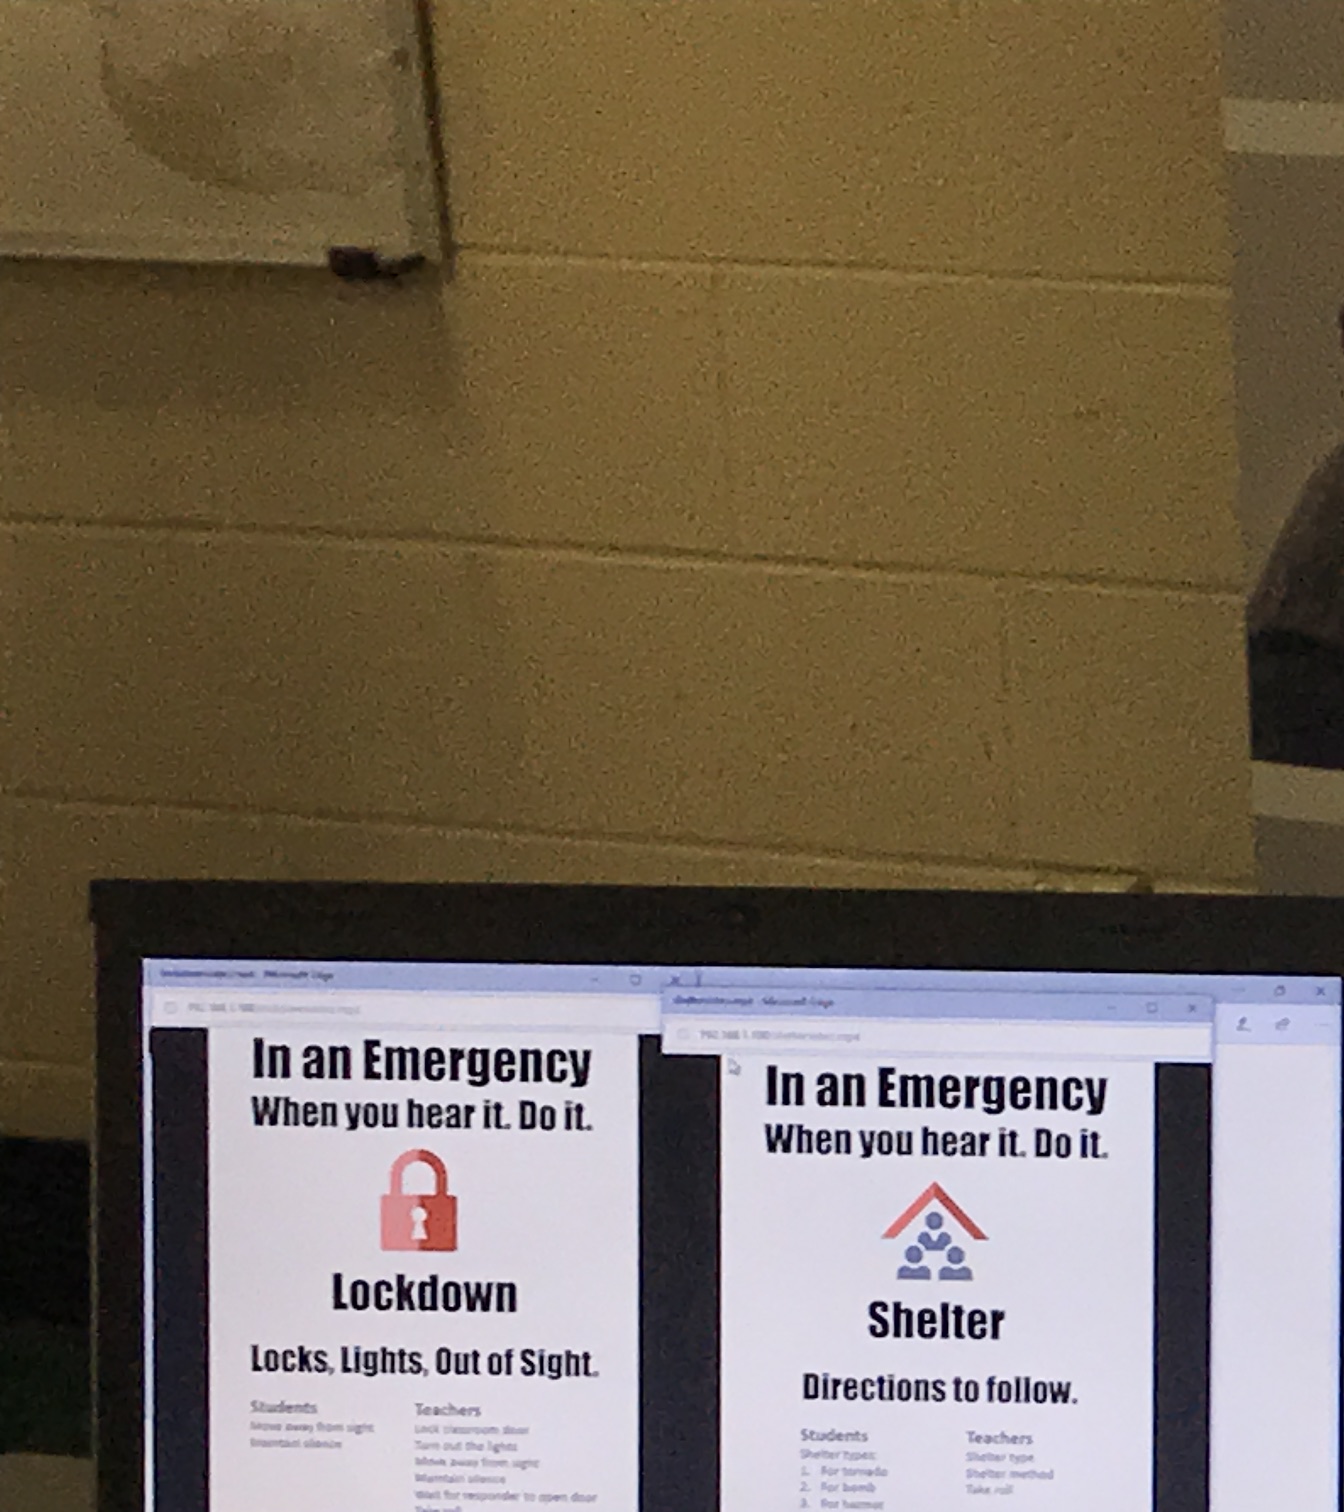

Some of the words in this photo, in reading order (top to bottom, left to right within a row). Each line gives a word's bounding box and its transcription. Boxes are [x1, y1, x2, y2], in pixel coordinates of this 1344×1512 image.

[253, 1037, 291, 1080] In
[302, 1044, 352, 1081] an
[363, 1038, 592, 1089] Emergency
[766, 1064, 805, 1107] In
[816, 1071, 866, 1109] an
[878, 1066, 1108, 1116] Emergency
[251, 1095, 338, 1129] When
[344, 1101, 399, 1132] you
[407, 1098, 476, 1130] hear
[483, 1099, 511, 1130] it.
[519, 1098, 556, 1132] Do
[564, 1099, 594, 1131] it.
[764, 1122, 852, 1156] When
[858, 1128, 913, 1159] you
[921, 1125, 990, 1158] hear
[998, 1127, 1026, 1158] it.
[1035, 1127, 1072, 1160] Do
[1080, 1127, 1108, 1159] it.
[332, 1272, 517, 1314] Lockdown
[868, 1300, 1005, 1341] Shelter
[251, 1344, 334, 1375] Locks,
[341, 1345, 428, 1377] Lights,
[435, 1346, 481, 1377] Out
[487, 1347, 514, 1377] of
[520, 1347, 601, 1382] Sight.
[250, 1399, 318, 1415] Students
[803, 1372, 946, 1404] Directions
[952, 1376, 980, 1404] to
[986, 1374, 1078, 1405] follow.
[414, 1402, 482, 1418] Teachers
[800, 1428, 869, 1443] Students
[966, 1430, 1034, 1446] Teachers
